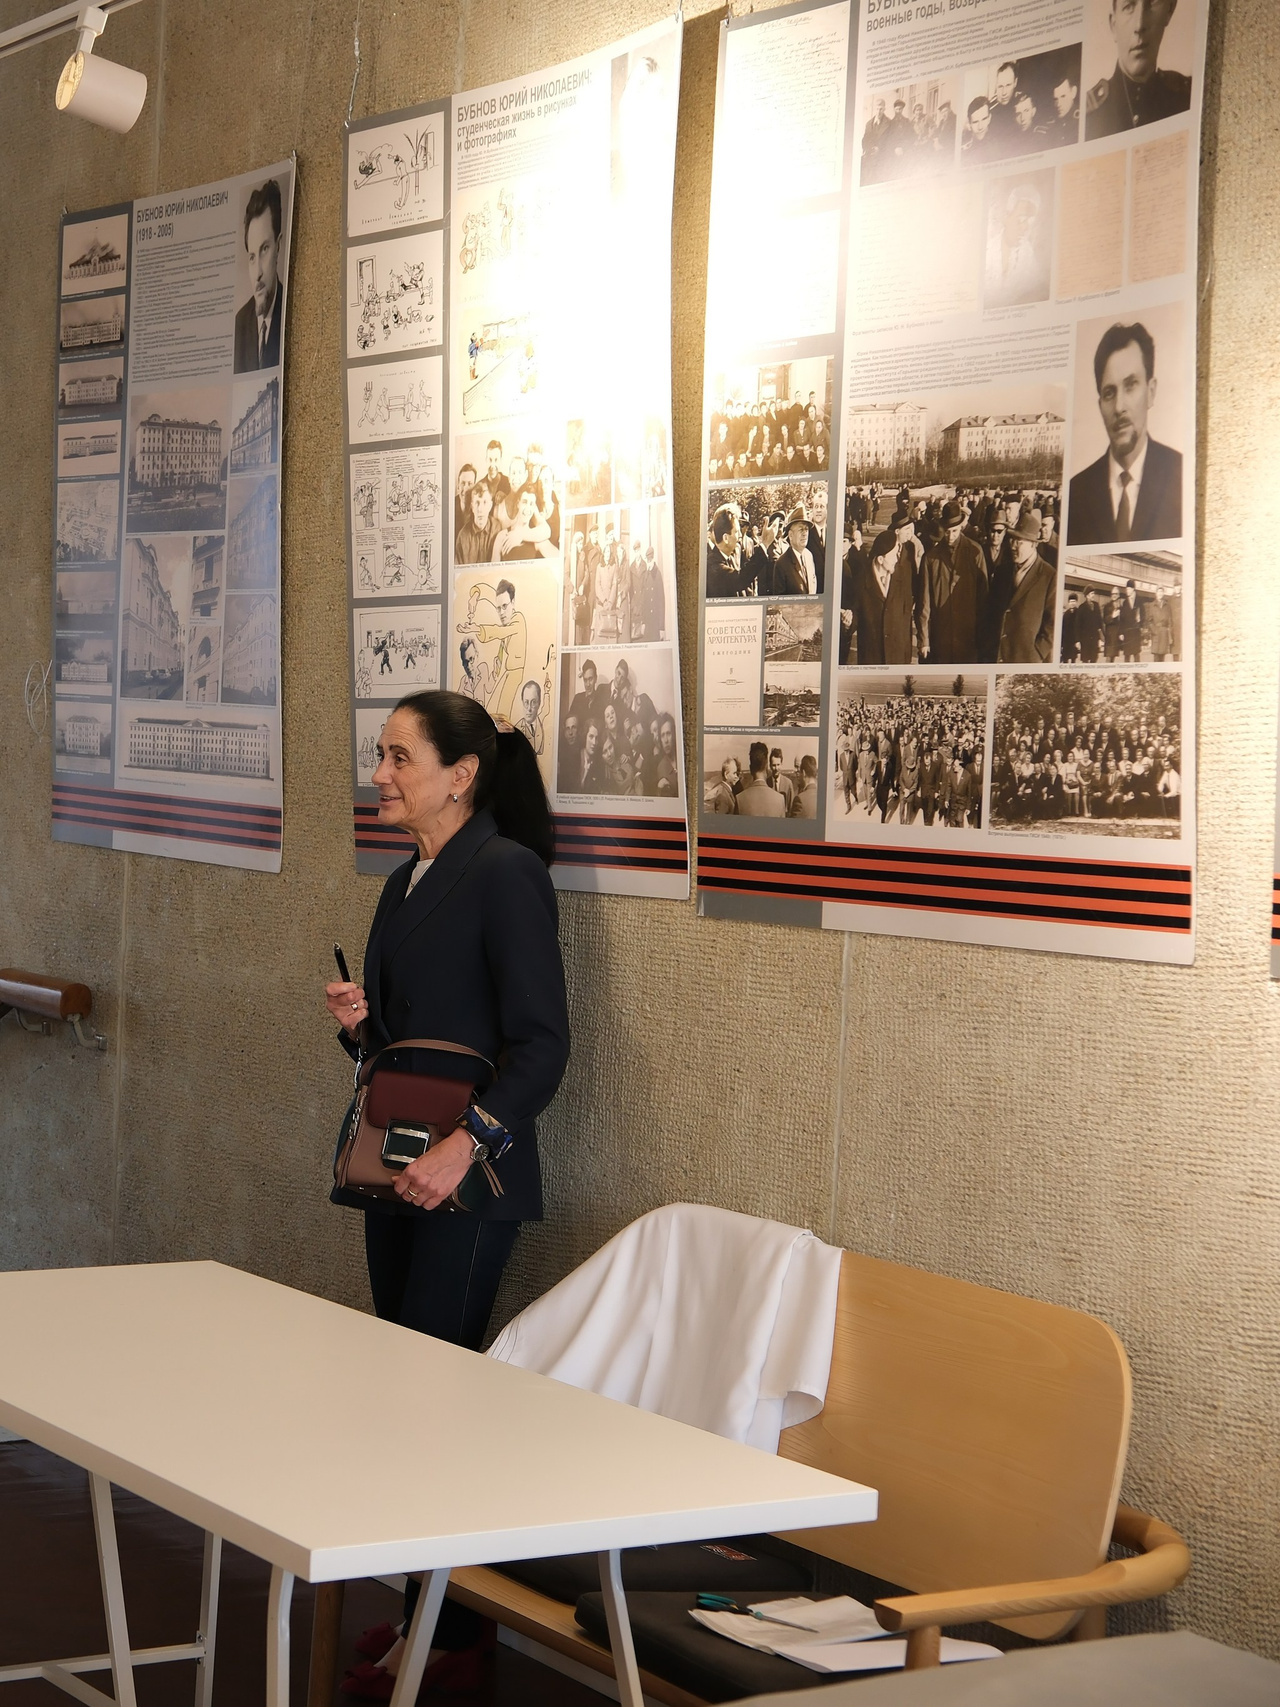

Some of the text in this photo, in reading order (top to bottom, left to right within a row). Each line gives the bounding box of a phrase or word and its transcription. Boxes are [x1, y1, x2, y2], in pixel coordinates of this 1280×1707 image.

[866, 8, 912, 32] военные
[916, 2, 946, 20] годы,
[457, 68, 592, 122] БУБНОВ ЮРИЙ НИКОЛАЕВИЧ:
[457, 95, 577, 138] студенческая жизнь в рисунках
[457, 128, 517, 152] и фотографиях
[137, 190, 228, 223] БУБНОВ ЮРИЙ НИКОЛАЕВИЧ
[136, 227, 152, 244] (1918
[157, 223, 174, 238] 2005)
[707, 626, 756, 635] СОВЕТСКАЯ
[707, 635, 757, 644] АРХИТЕКТУРА
